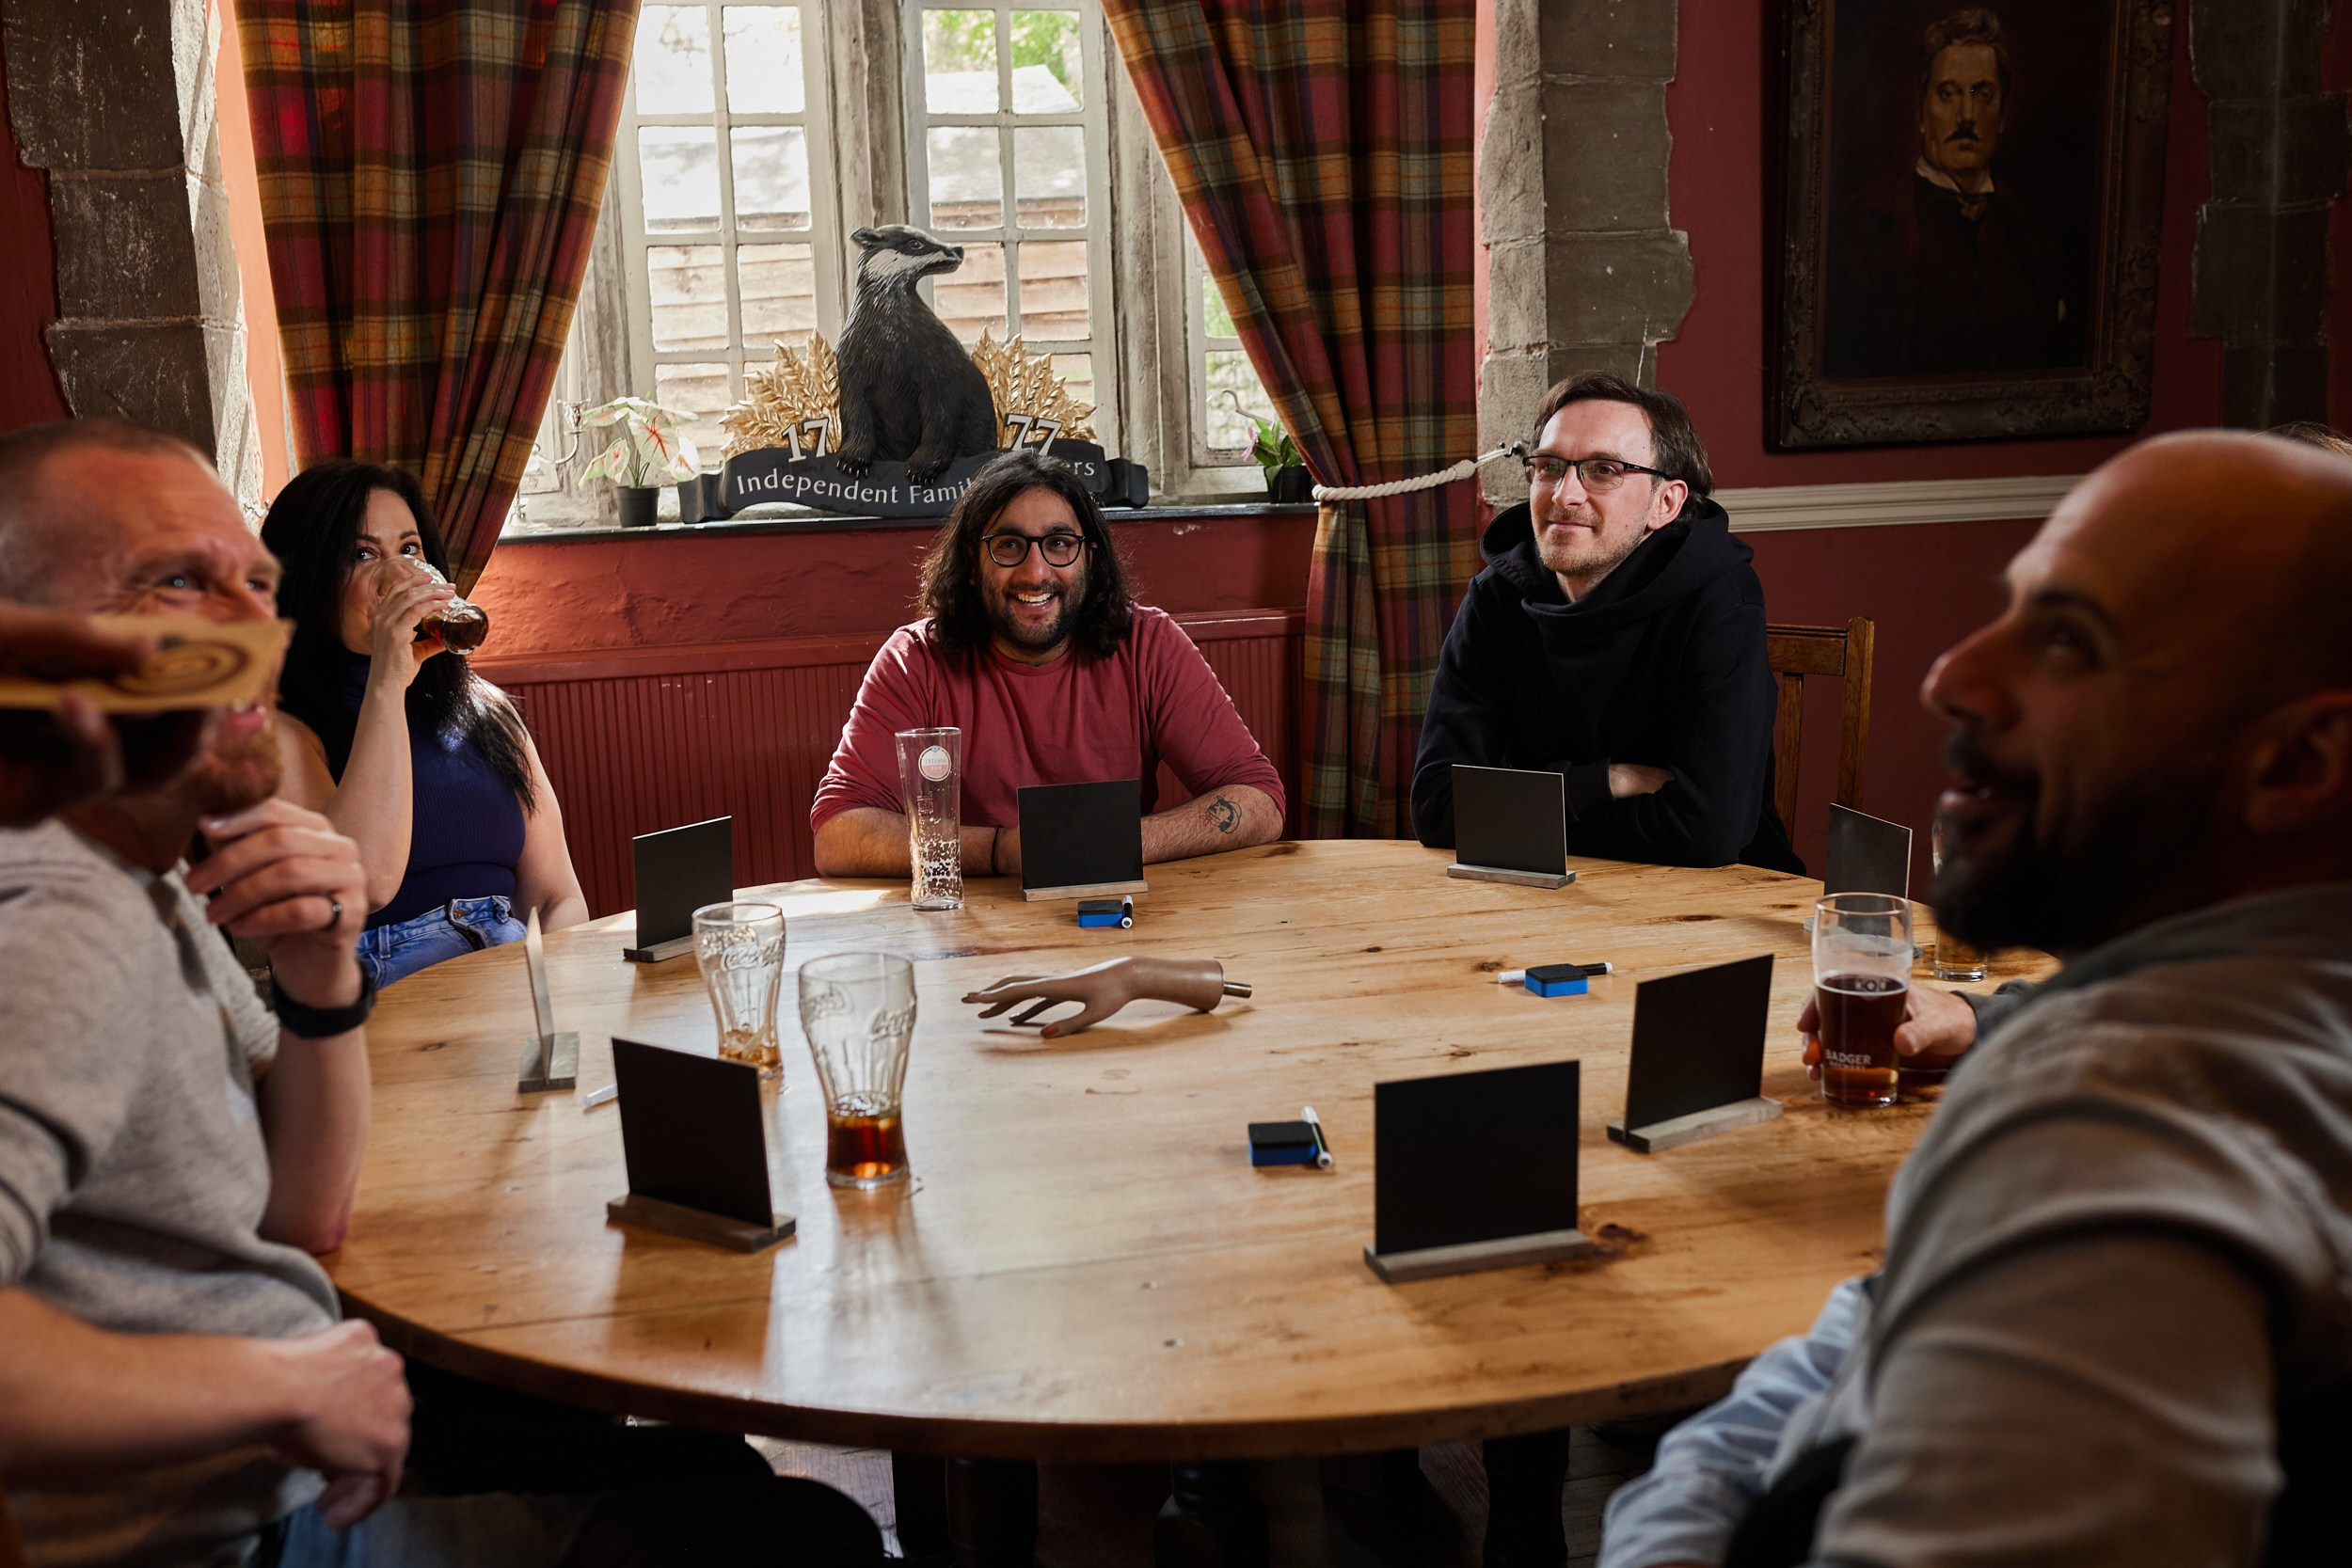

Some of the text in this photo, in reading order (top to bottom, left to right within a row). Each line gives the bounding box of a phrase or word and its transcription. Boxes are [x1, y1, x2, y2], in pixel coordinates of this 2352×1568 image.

[782, 414, 1063, 463] 17 77
[737, 468, 972, 504] Independent Famil
[1825, 1049, 1871, 1065] BADGER
